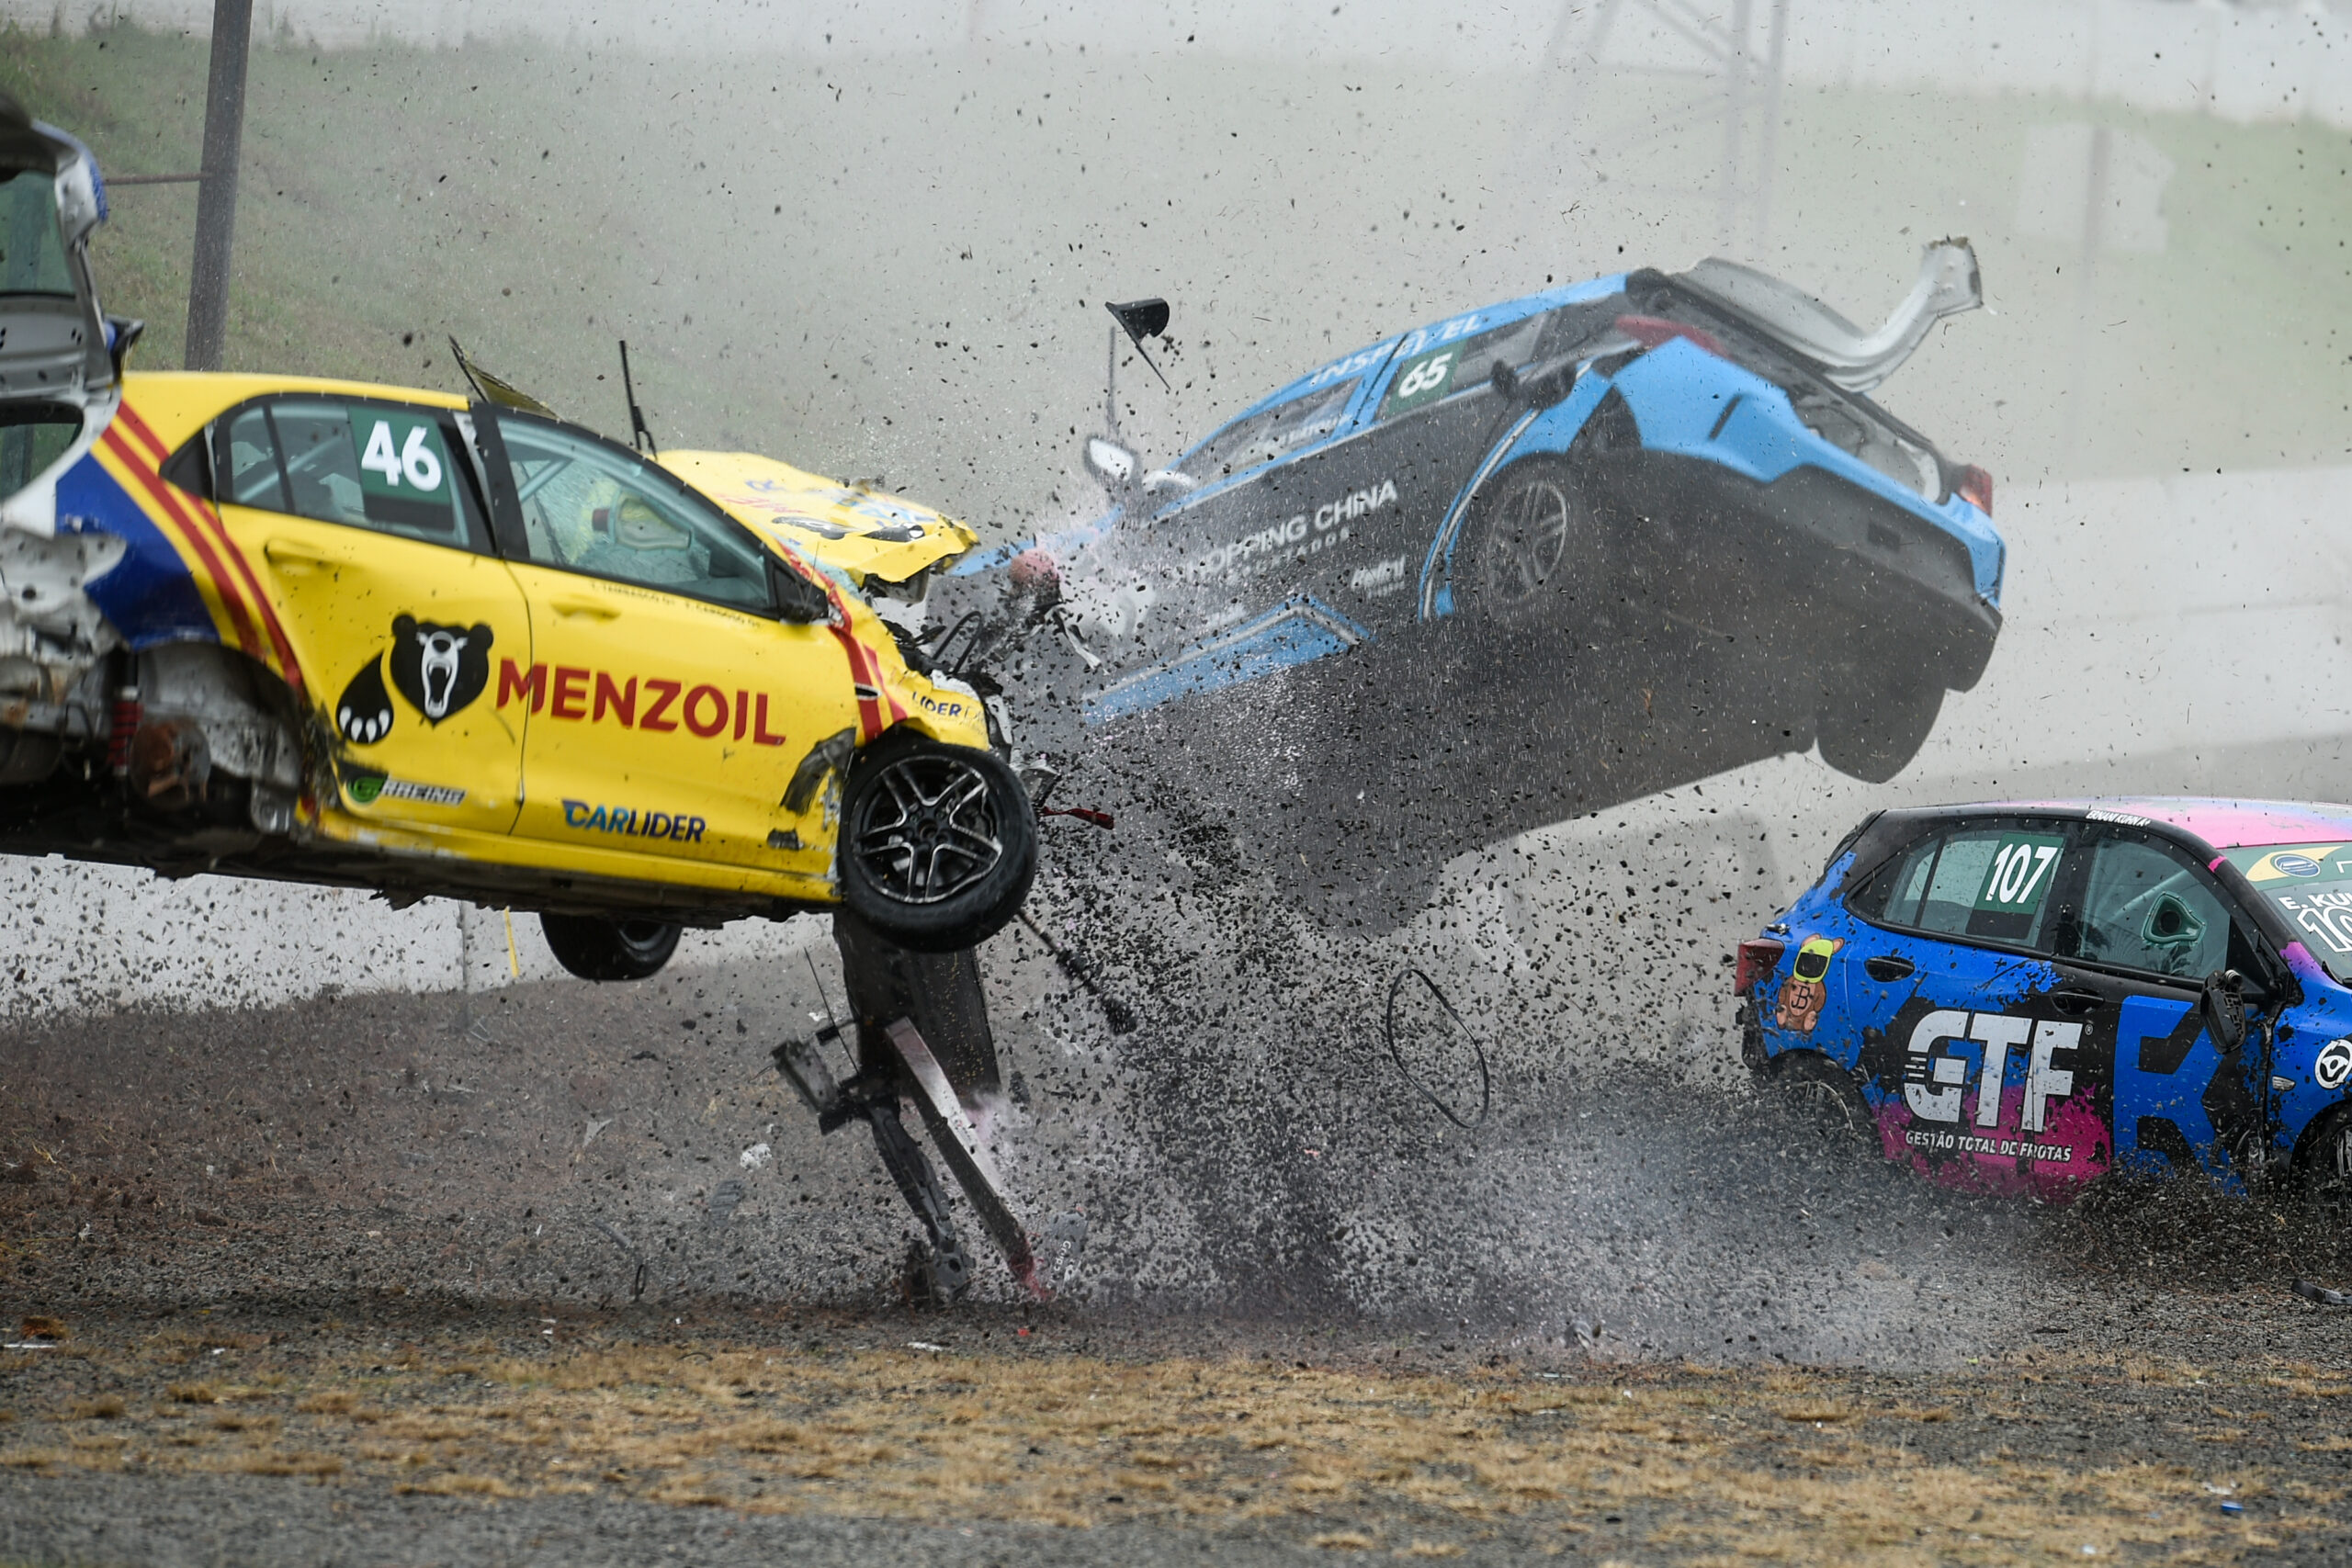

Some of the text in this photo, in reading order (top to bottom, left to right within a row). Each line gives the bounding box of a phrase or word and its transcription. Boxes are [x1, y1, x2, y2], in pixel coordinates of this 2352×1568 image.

[1397, 352, 1453, 398] 65
[361, 420, 442, 491] 46
[1315, 479, 1397, 531] CHINA
[496, 657, 786, 746] MENZOIL
[561, 798, 707, 842] CARLIDER
[1984, 843, 2058, 904] 107
[2278, 892, 2352, 910] E. KU
[1904, 1010, 2083, 1132] GTF
[1905, 1131, 1954, 1149] GESTÃO
[1958, 1136, 1996, 1154] TOTAL
